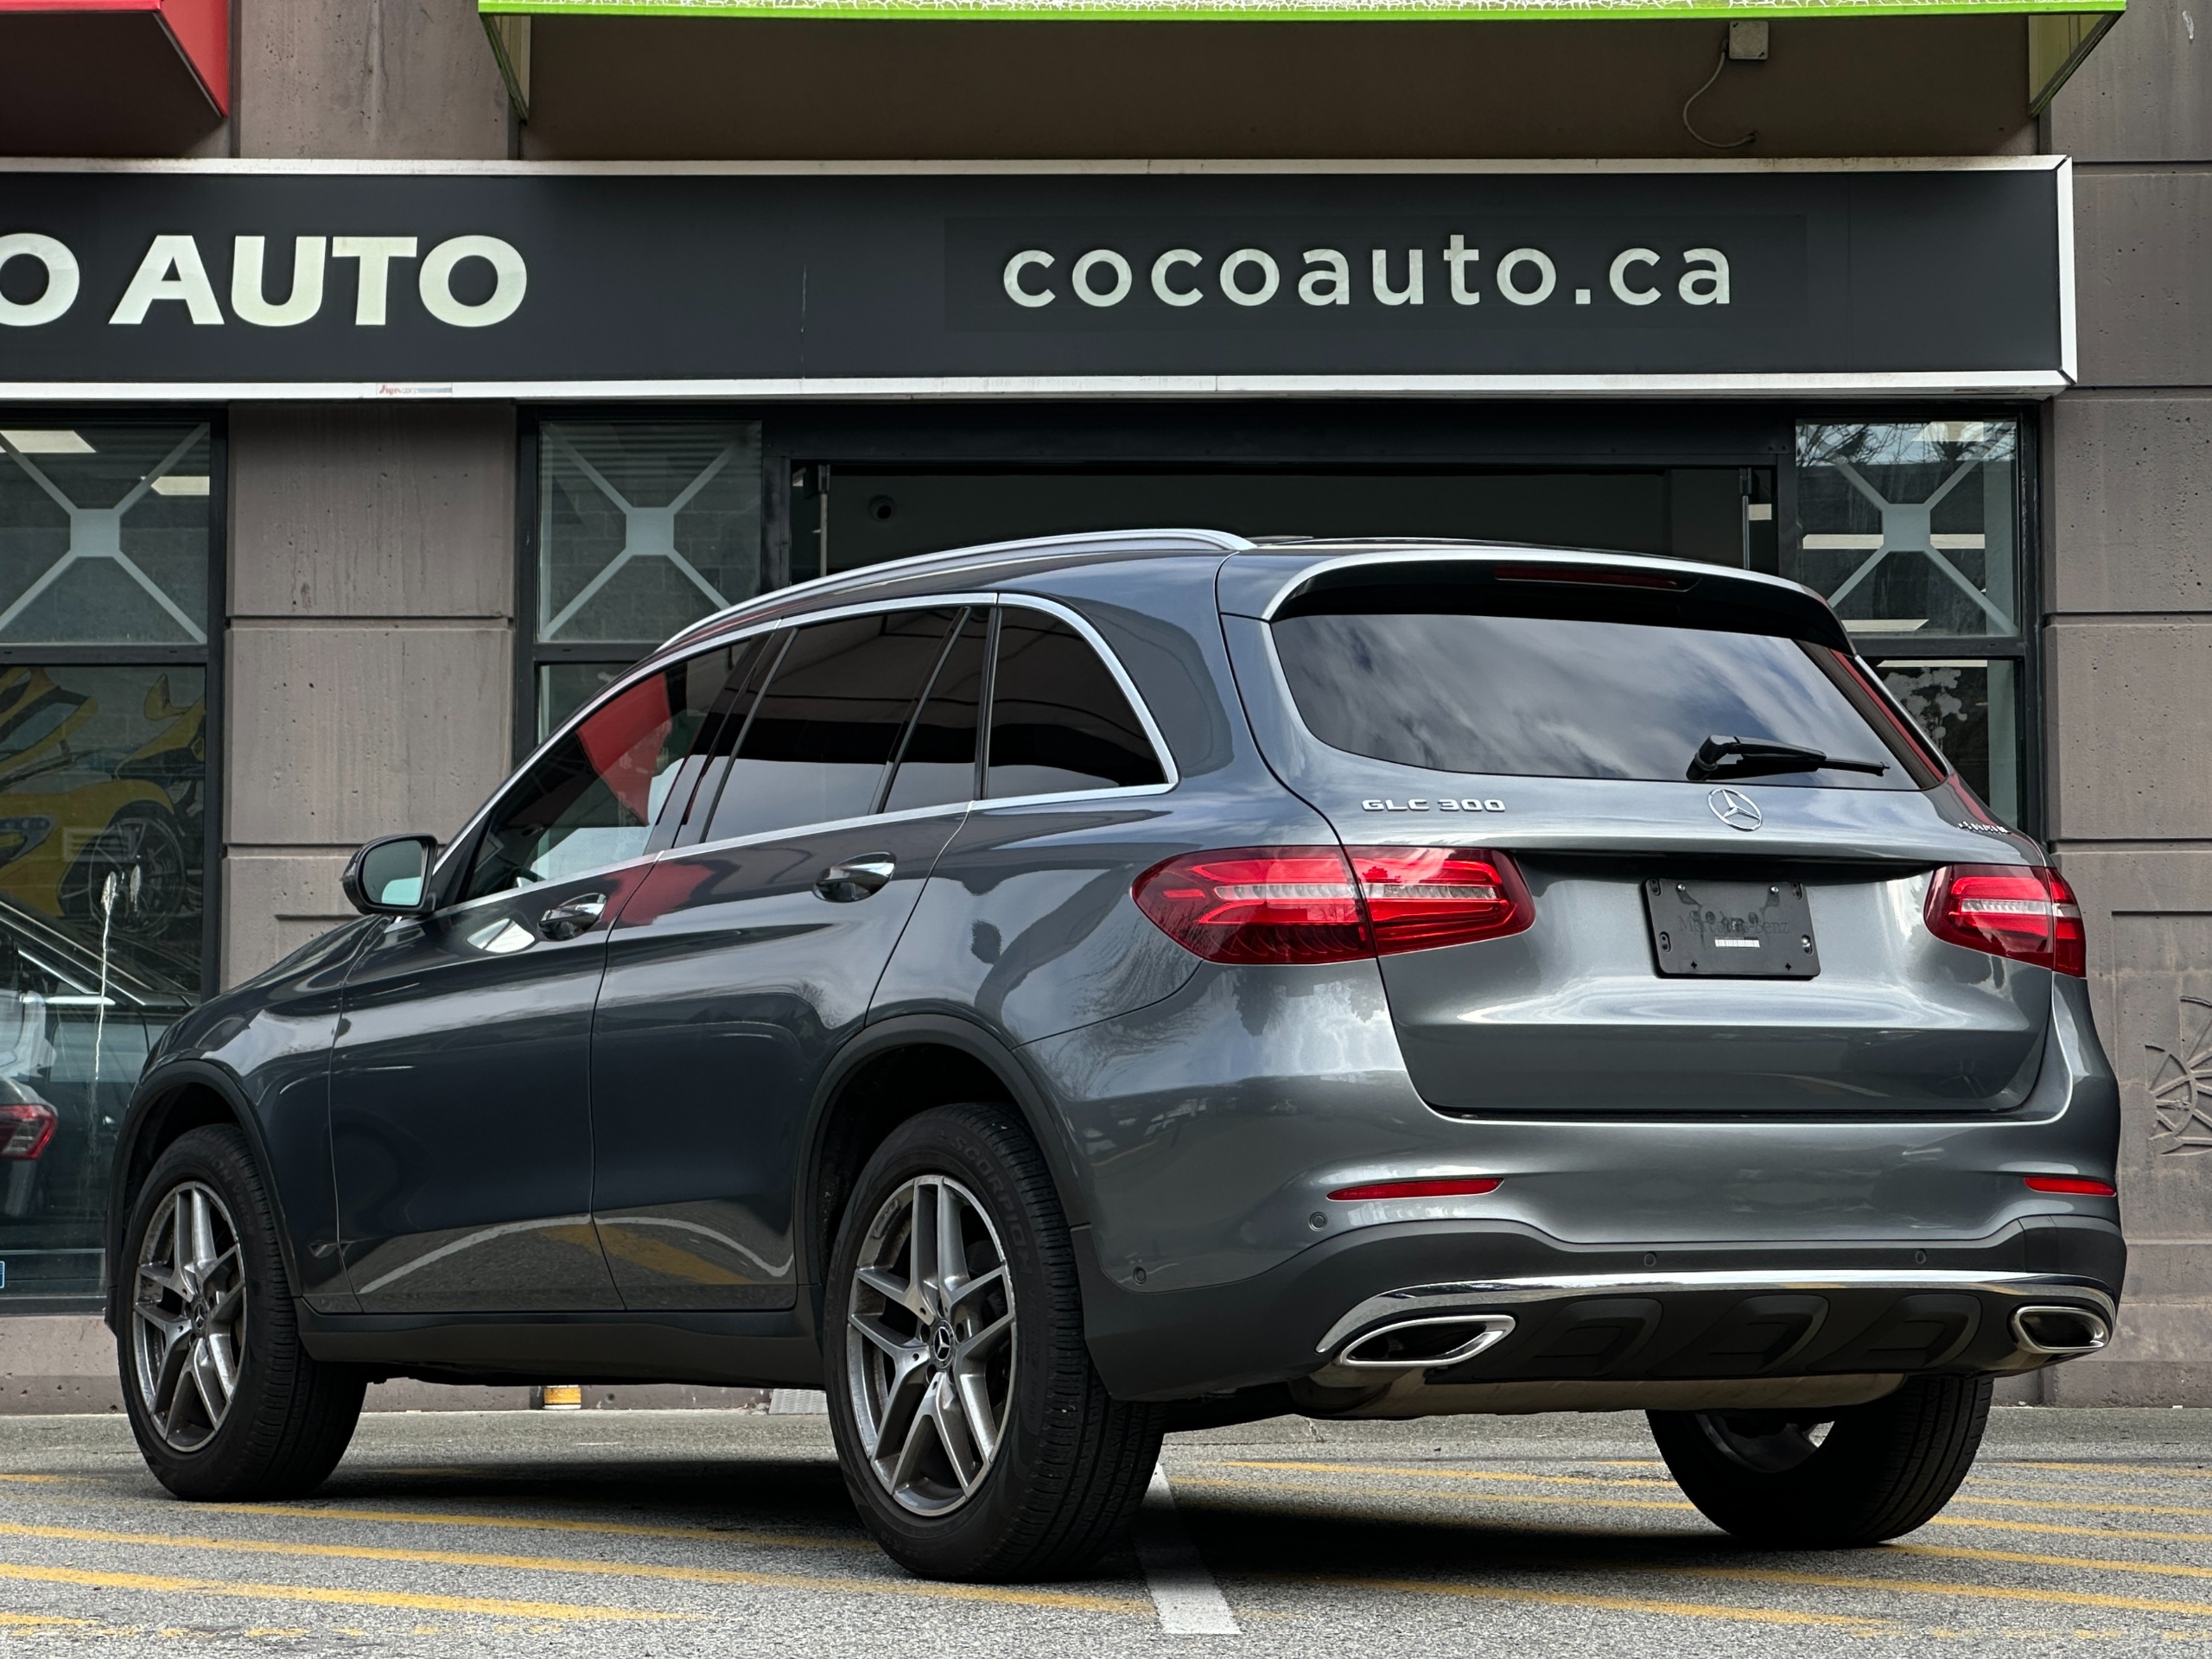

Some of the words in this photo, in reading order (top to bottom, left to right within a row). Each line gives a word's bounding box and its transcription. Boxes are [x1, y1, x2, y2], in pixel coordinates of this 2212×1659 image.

[0, 233, 79, 327] O
[109, 235, 528, 327] AUTO
[1003, 234, 1732, 308] cocoauto.ca
[1361, 798, 1430, 812] GLC
[1437, 798, 1506, 813] 300
[1677, 915, 1789, 935] Merces-Benz
